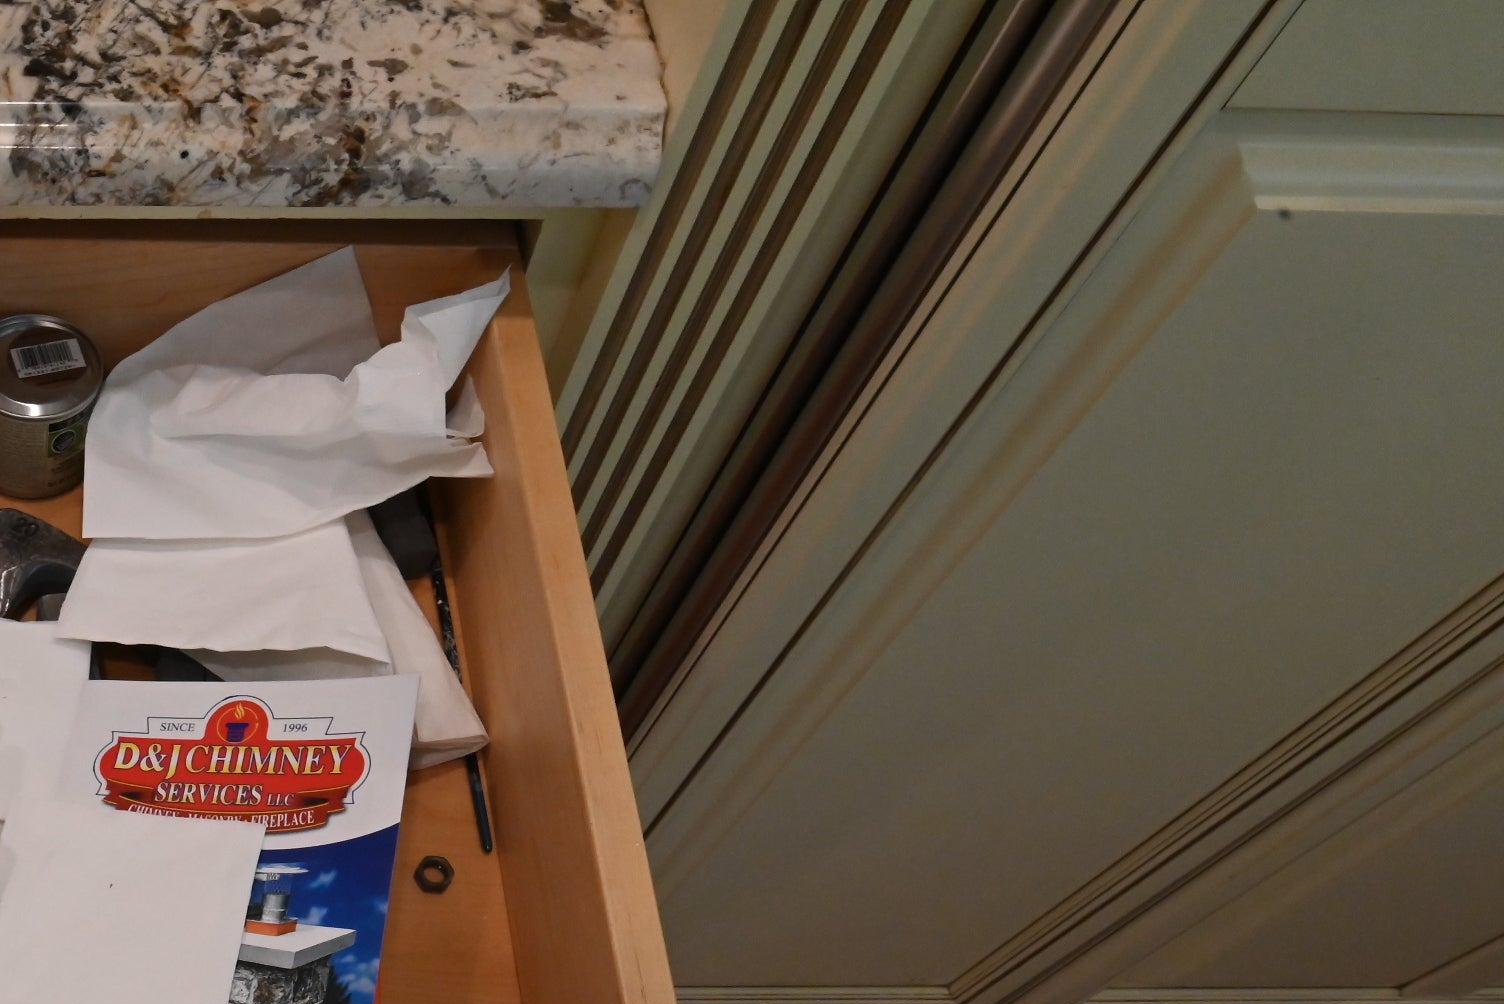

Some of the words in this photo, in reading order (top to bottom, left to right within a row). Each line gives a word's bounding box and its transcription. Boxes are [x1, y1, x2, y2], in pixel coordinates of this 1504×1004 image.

[159, 722, 196, 733] SINCE
[282, 722, 308, 733] 1996
[114, 742, 180, 780] D&J
[185, 744, 354, 776] CHIMNEY
[154, 782, 264, 806] SERVICES
[266, 792, 296, 806] LLC
[251, 810, 314, 828] FIREPLACE
